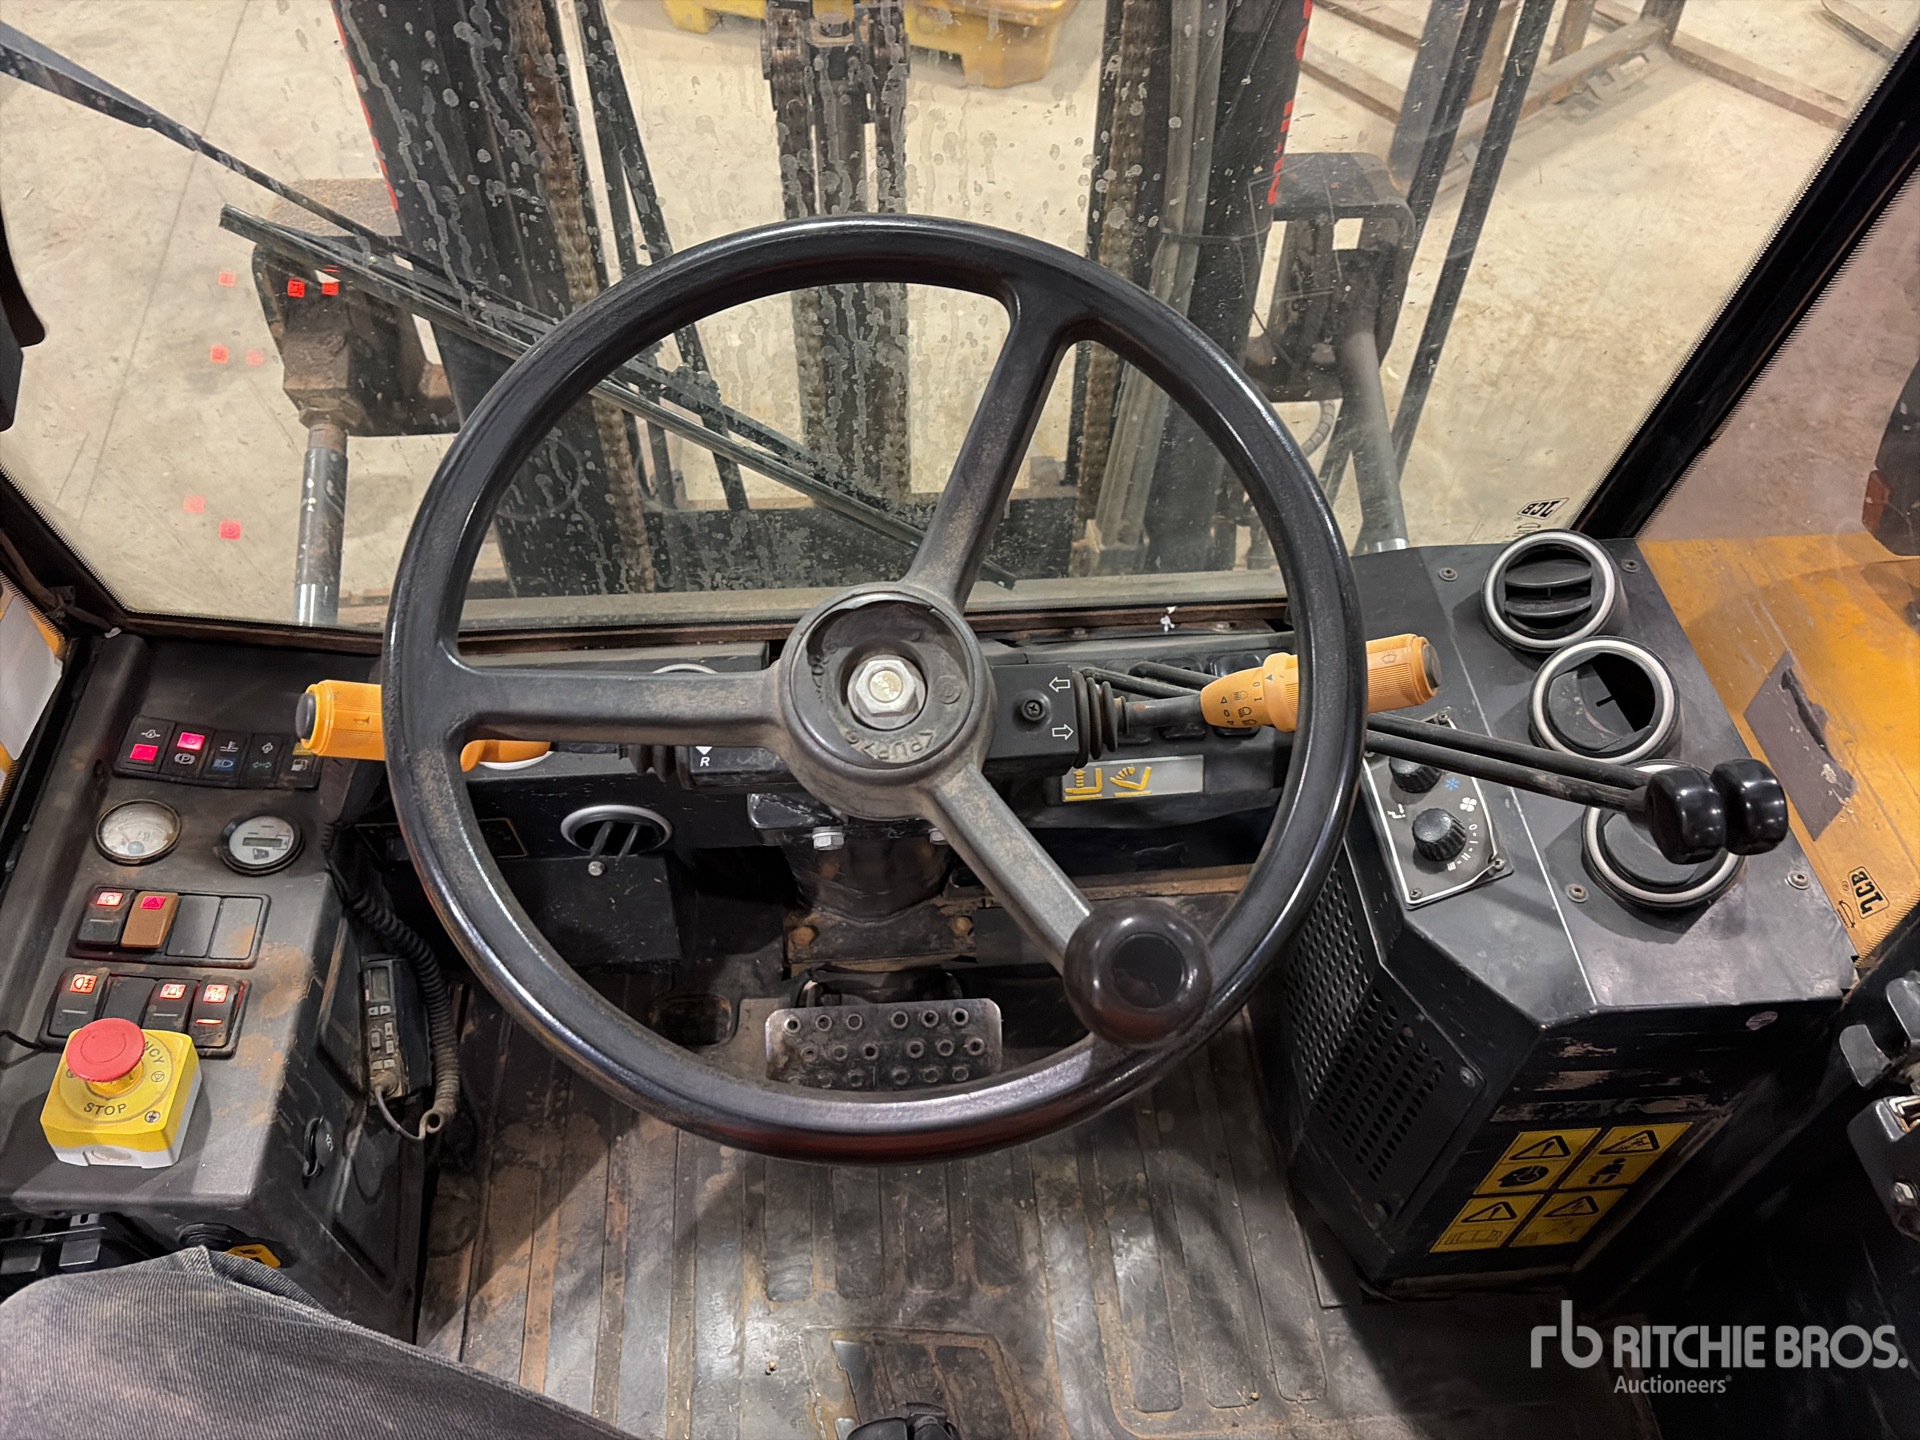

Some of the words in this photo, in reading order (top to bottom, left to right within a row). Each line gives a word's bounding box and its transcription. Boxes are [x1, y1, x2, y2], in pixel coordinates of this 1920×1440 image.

[1521, 500, 1561, 518] JCB
[700, 756, 711, 767] R
[1851, 870, 1884, 915] JCB
[83, 1101, 127, 1118] STOP
